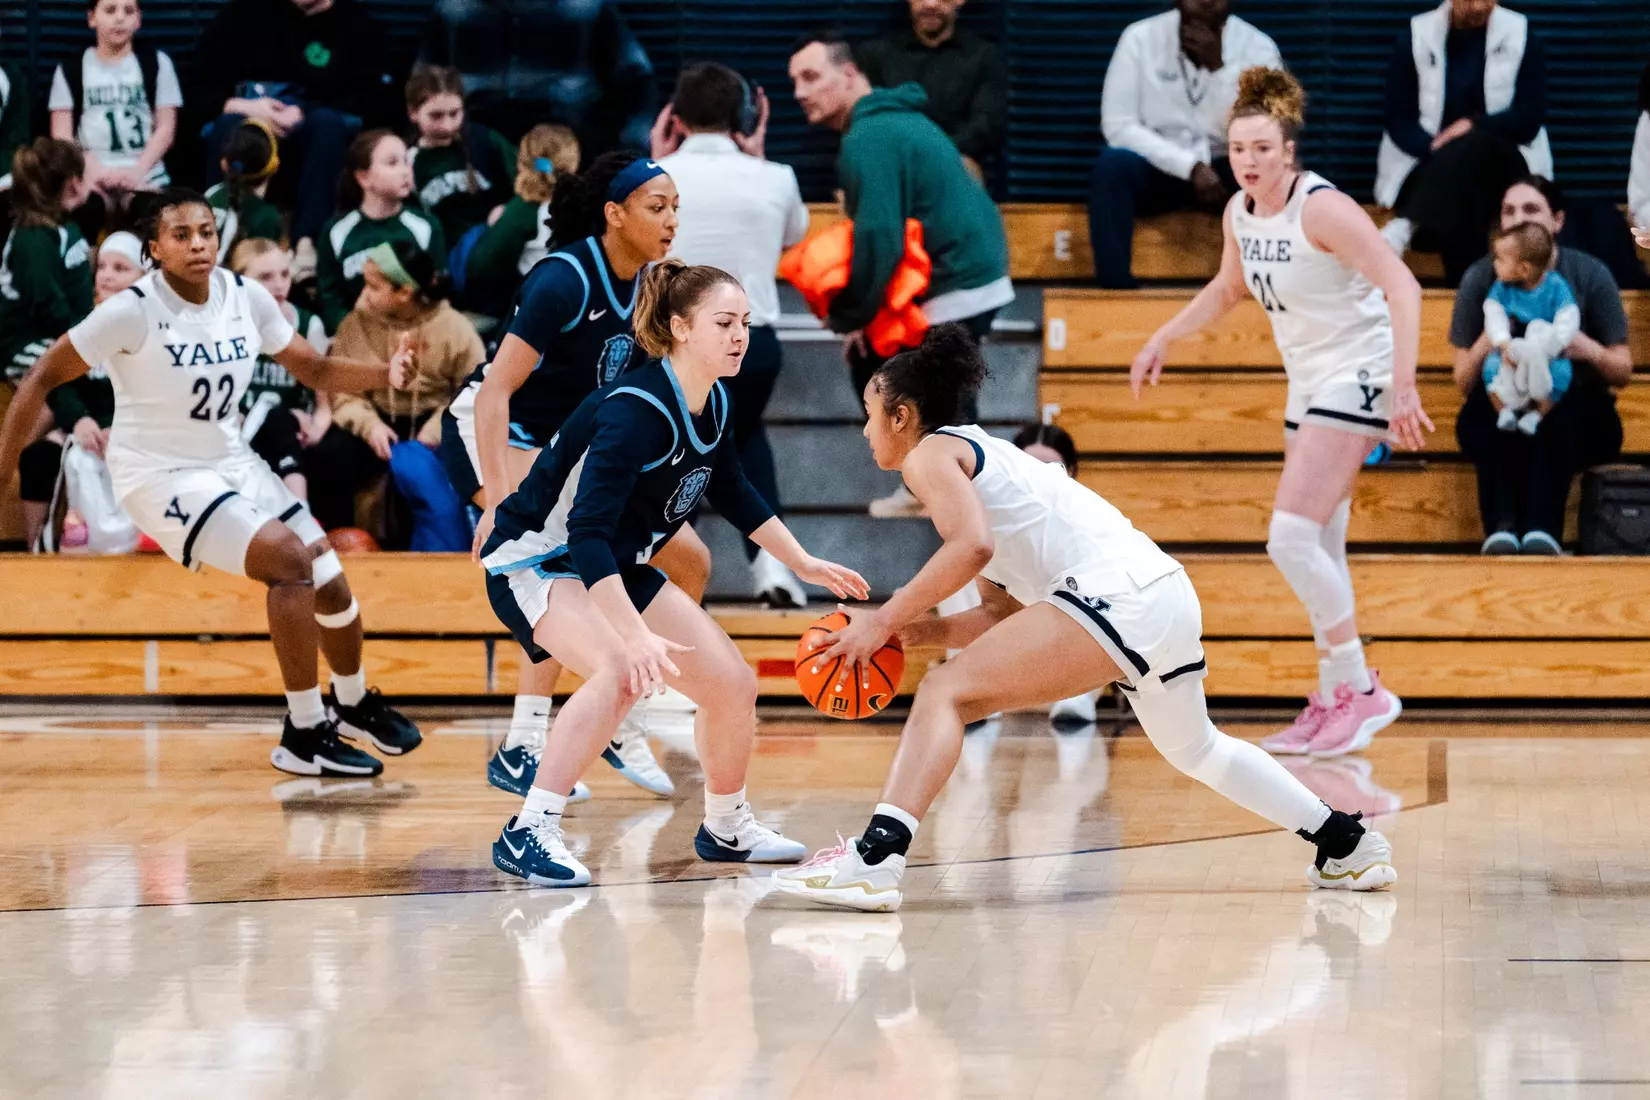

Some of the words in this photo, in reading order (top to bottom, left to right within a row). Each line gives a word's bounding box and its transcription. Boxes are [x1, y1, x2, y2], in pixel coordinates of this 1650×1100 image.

[105, 110, 146, 152] 13
[1055, 230, 1072, 261] E
[1241, 237, 1292, 262] YALE
[1252, 271, 1287, 312] 21
[164, 336, 249, 367] YALE
[190, 373, 234, 421] 22
[1359, 384, 1383, 412] Y
[164, 495, 190, 526] Y
